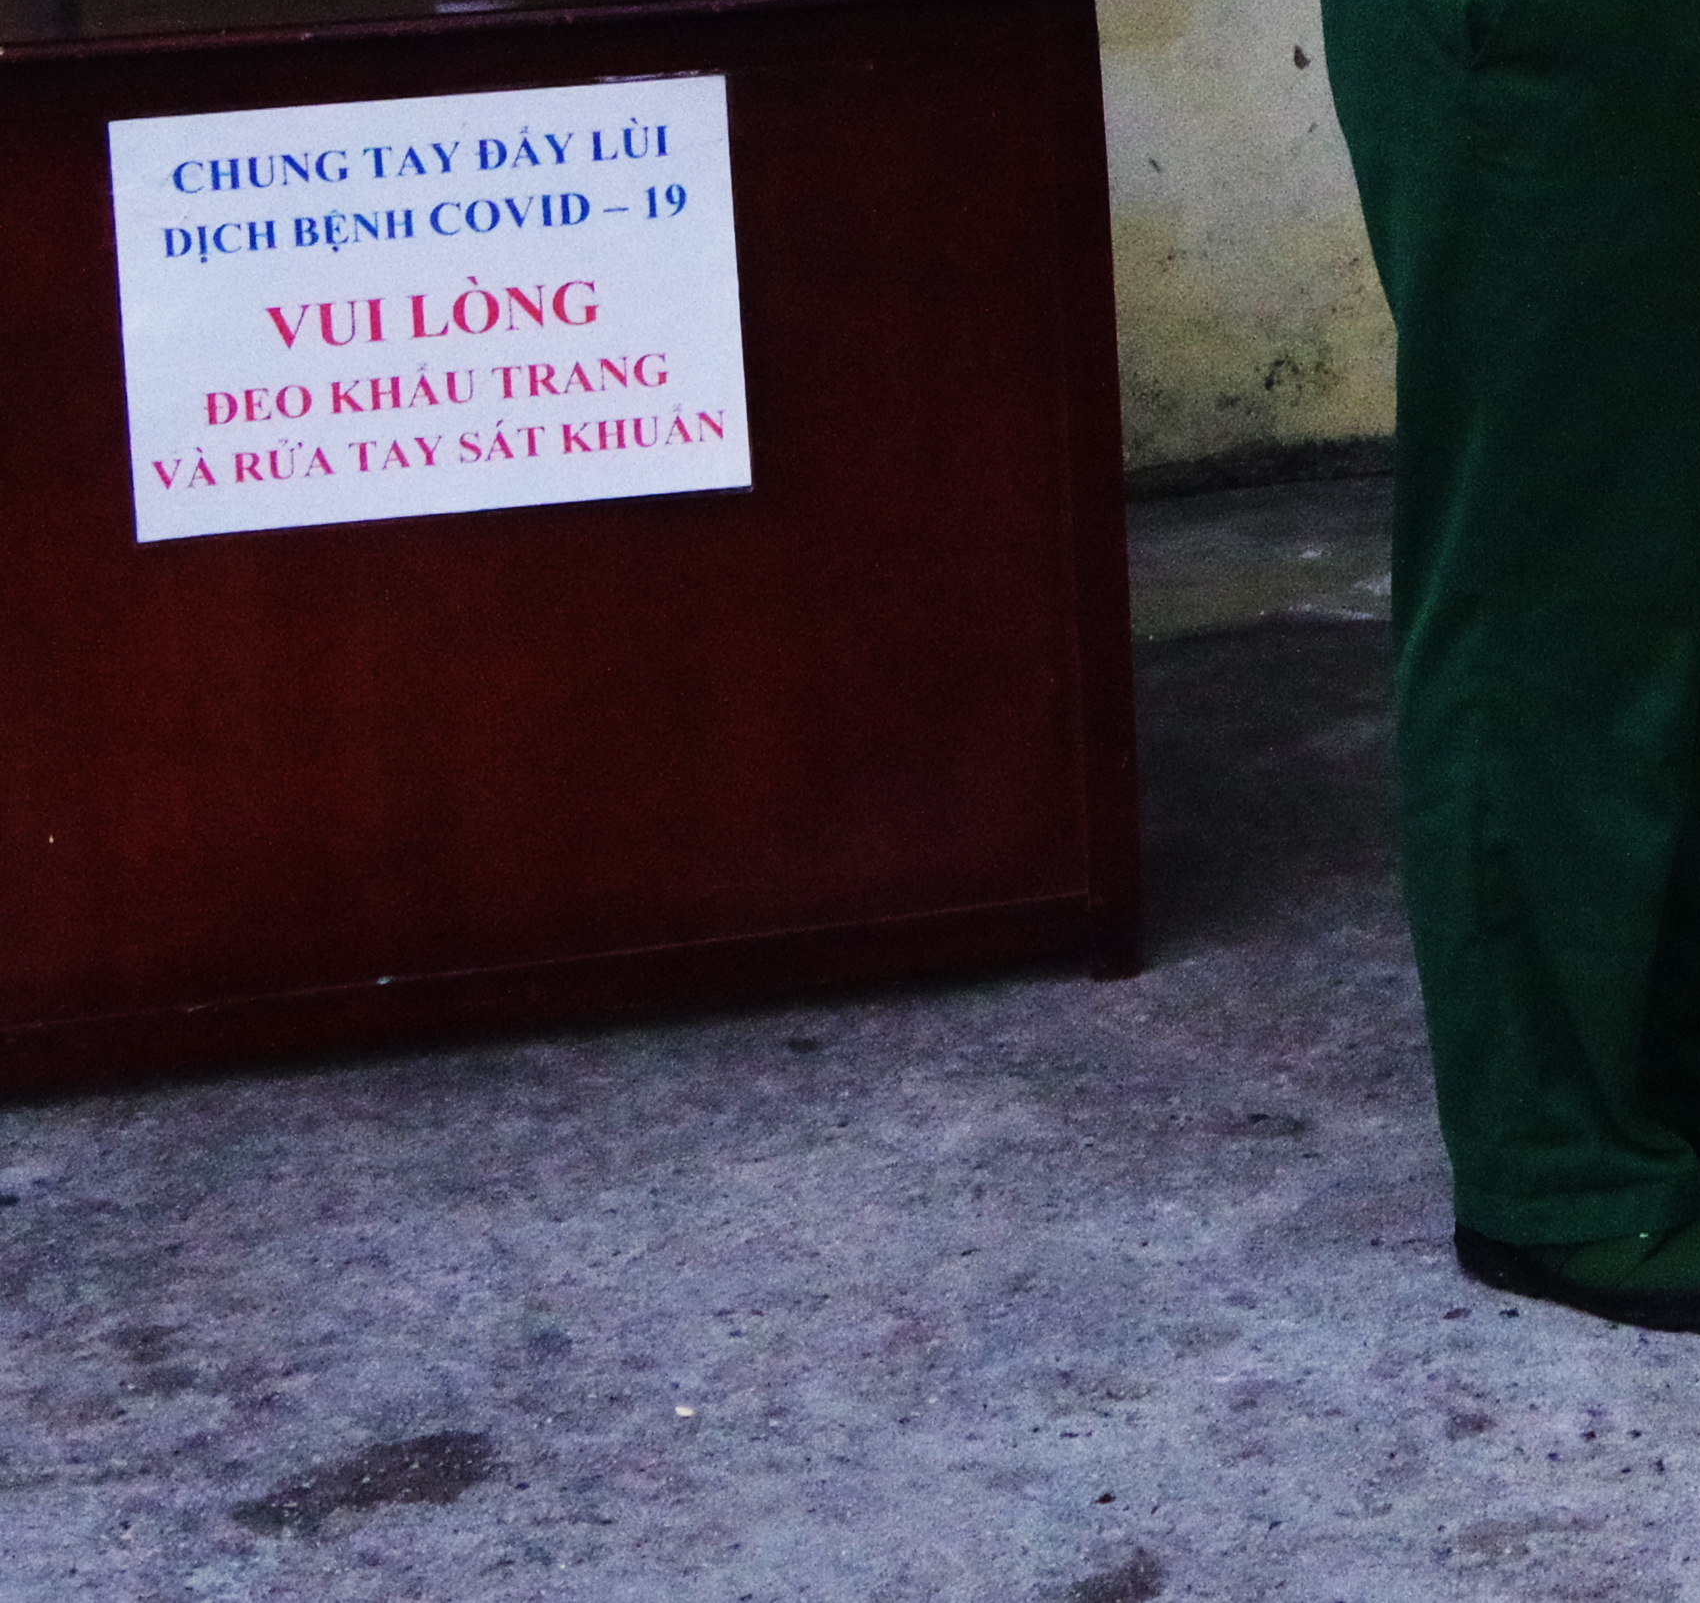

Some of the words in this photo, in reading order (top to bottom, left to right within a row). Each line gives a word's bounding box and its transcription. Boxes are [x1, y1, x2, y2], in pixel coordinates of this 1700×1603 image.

[171, 149, 350, 194] CHUNG
[362, 141, 460, 179] TAY
[474, 125, 575, 172] ĐẨY
[592, 116, 668, 162] LÙI
[162, 219, 277, 264] DỊCH
[293, 208, 415, 253] BỆNH
[429, 192, 591, 236] COVID
[646, 183, 688, 219] 19
[265, 297, 386, 350] VUI
[407, 275, 600, 340] LÒNG
[204, 384, 313, 426] ĐEO
[330, 362, 475, 415] KHẨU
[491, 352, 669, 400] TRANG
[151, 446, 218, 490] VÀ
[232, 439, 336, 484] RỬA
[348, 434, 442, 472] TAY
[458, 419, 546, 464] SÁT
[561, 402, 726, 456] KHUẨN
